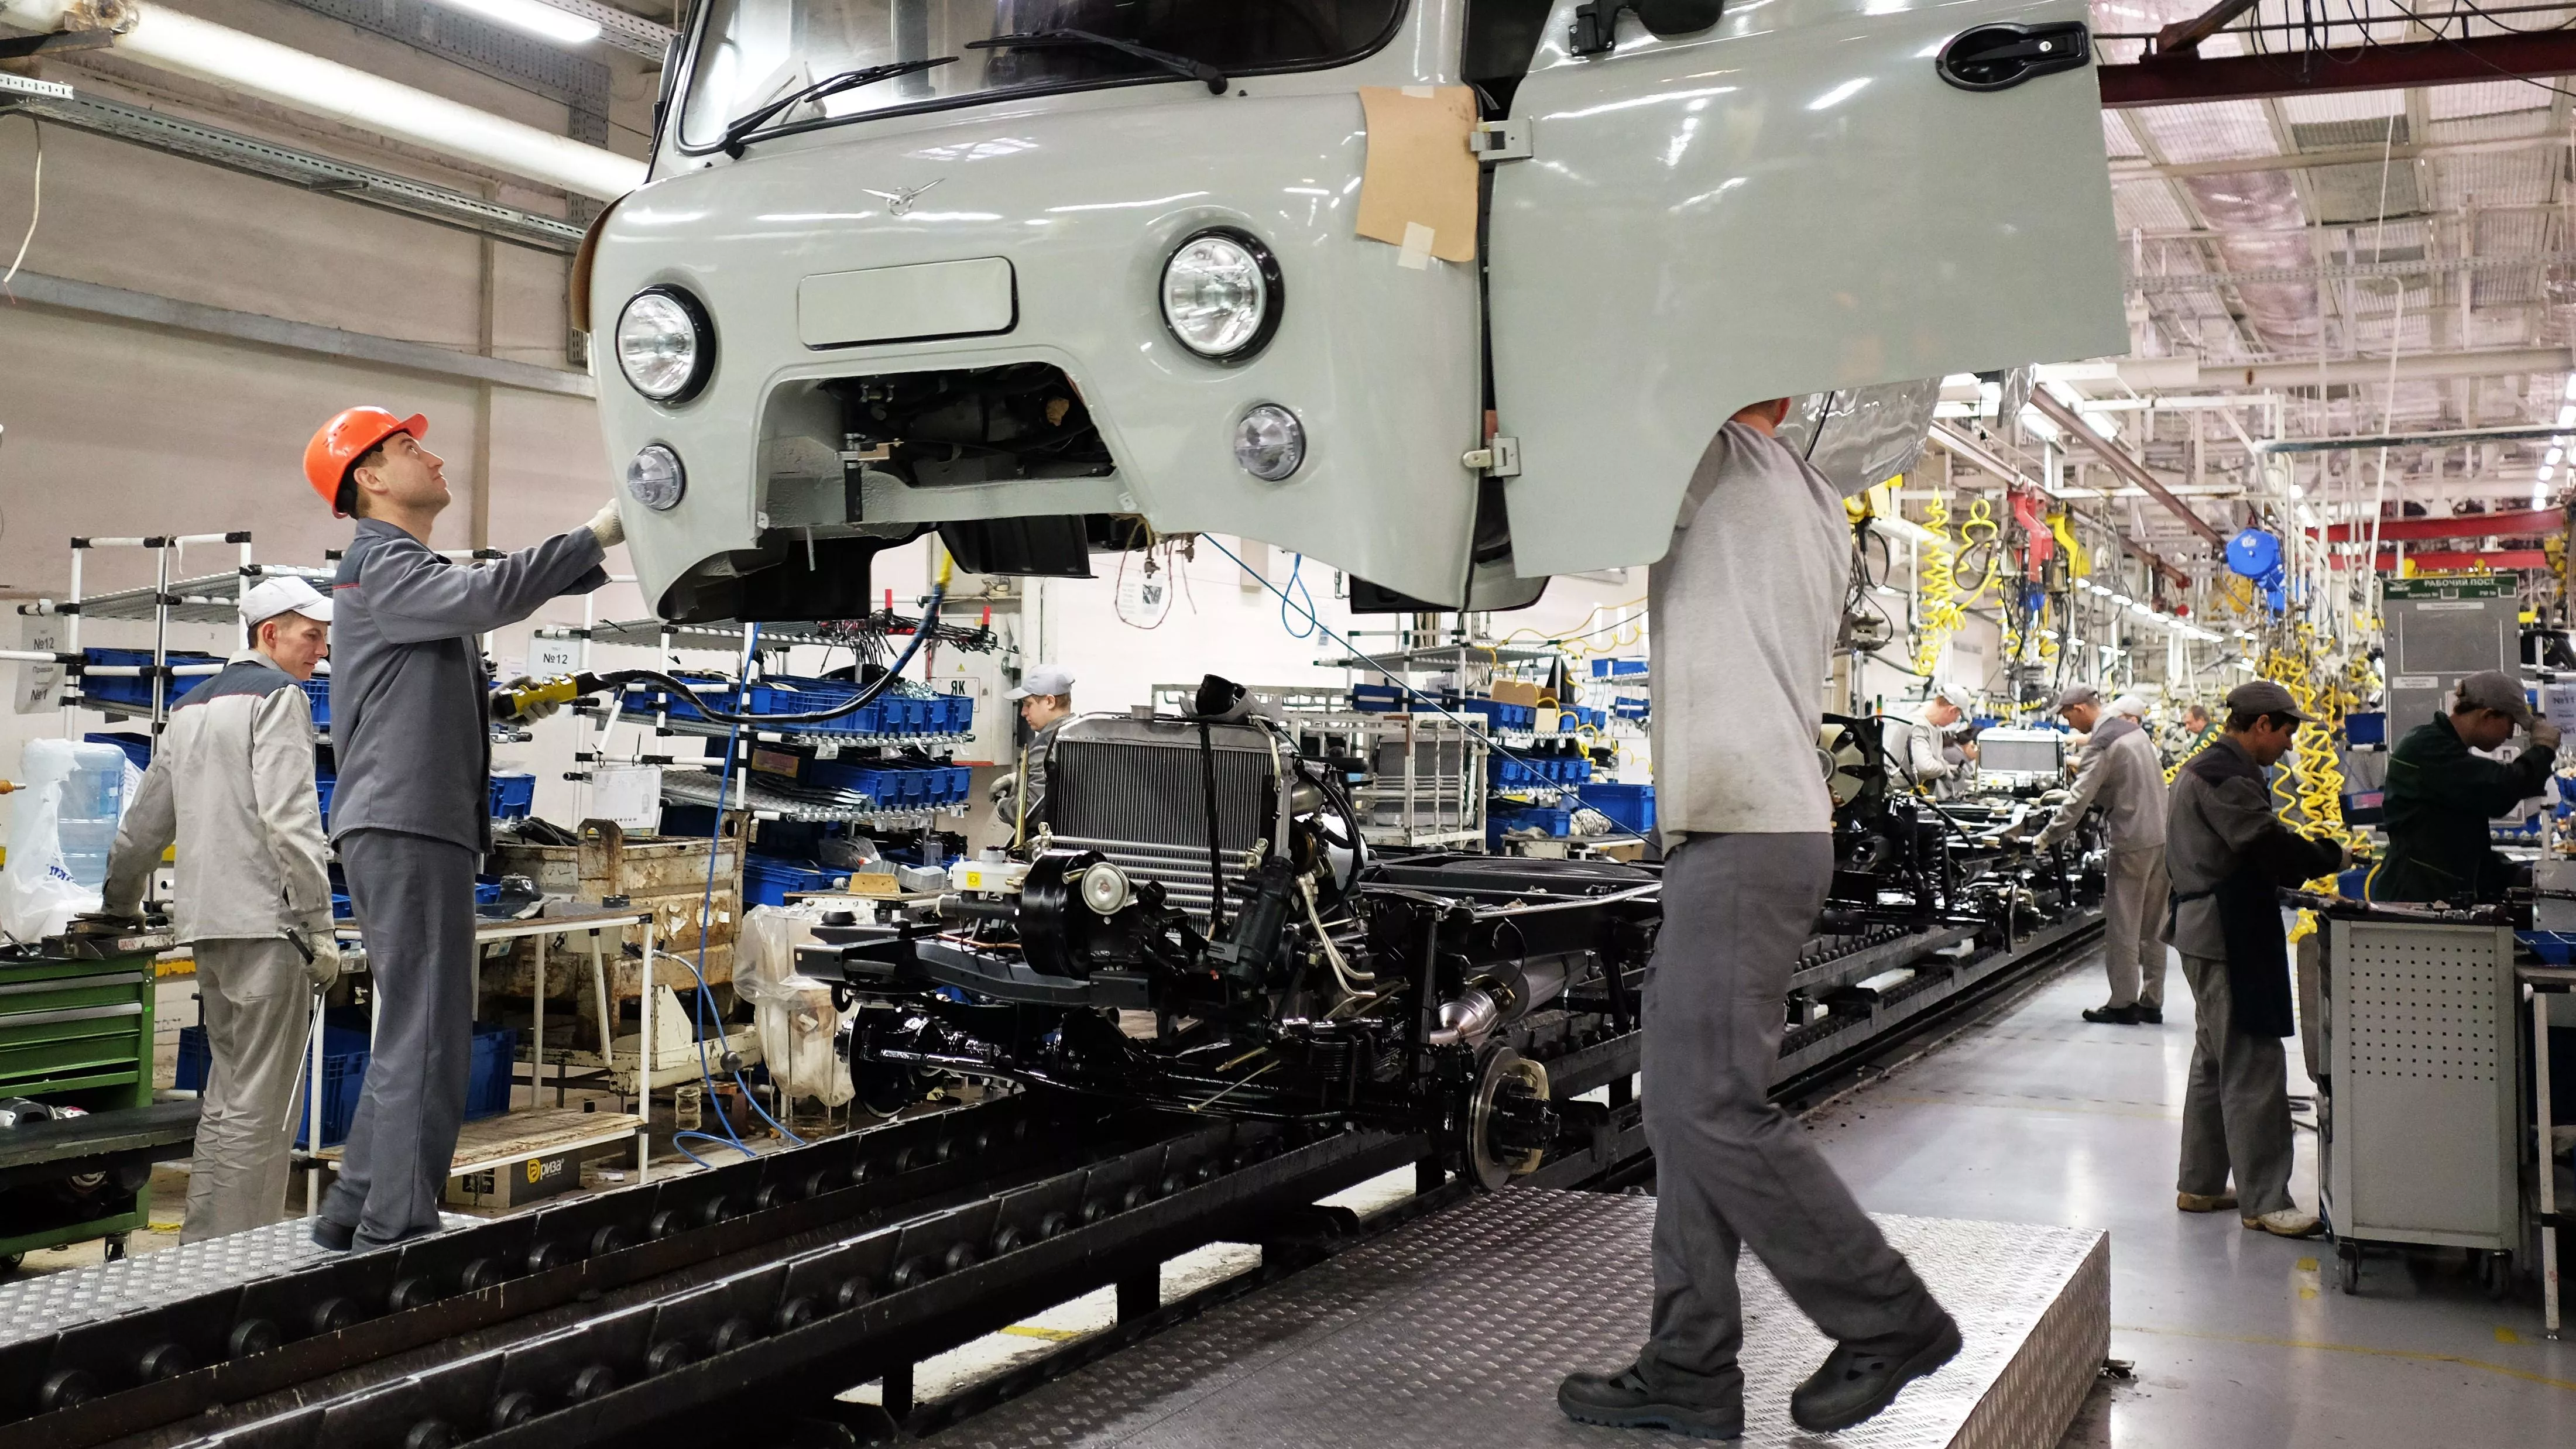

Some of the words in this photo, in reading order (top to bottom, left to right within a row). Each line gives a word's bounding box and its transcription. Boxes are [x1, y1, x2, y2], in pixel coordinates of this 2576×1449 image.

[33, 637, 54, 650] №12
[543, 653, 568, 665] №12
[951, 680, 965, 695] ЯК
[30, 688, 48, 701] №1
